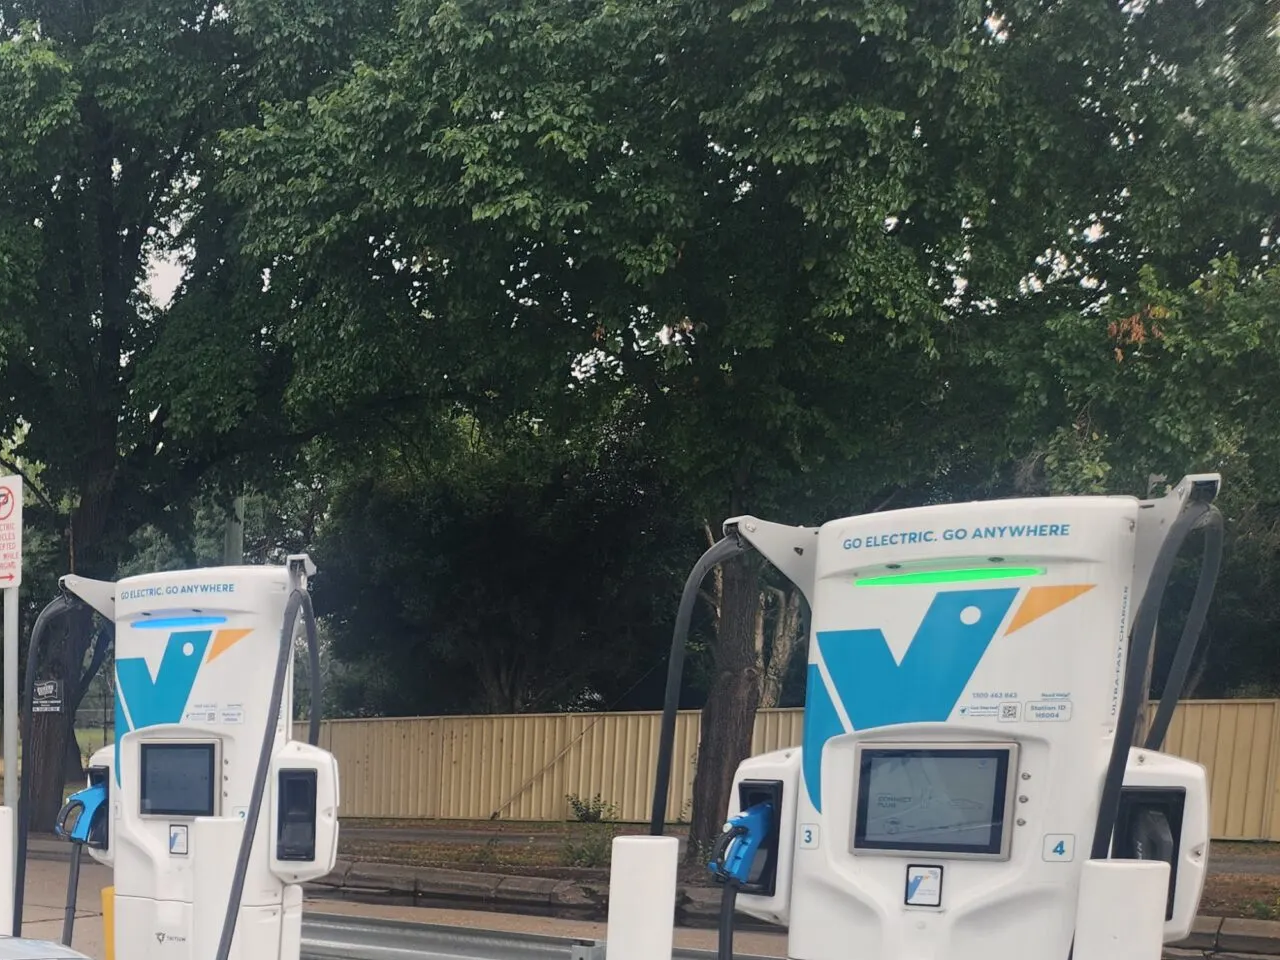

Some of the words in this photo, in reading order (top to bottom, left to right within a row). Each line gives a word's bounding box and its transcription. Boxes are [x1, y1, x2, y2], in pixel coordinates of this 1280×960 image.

[842, 537, 862, 550] GO
[865, 531, 938, 548] ELECTRIC.
[942, 528, 967, 541] GO
[971, 524, 1071, 539] ANYWHERE
[120, 591, 129, 600] GO
[130, 587, 164, 599] ELECTRIC.
[165, 585, 179, 595] GO
[180, 583, 235, 594] ANYWHERE
[804, 830, 812, 843] 3
[1052, 840, 1066, 856] 4
